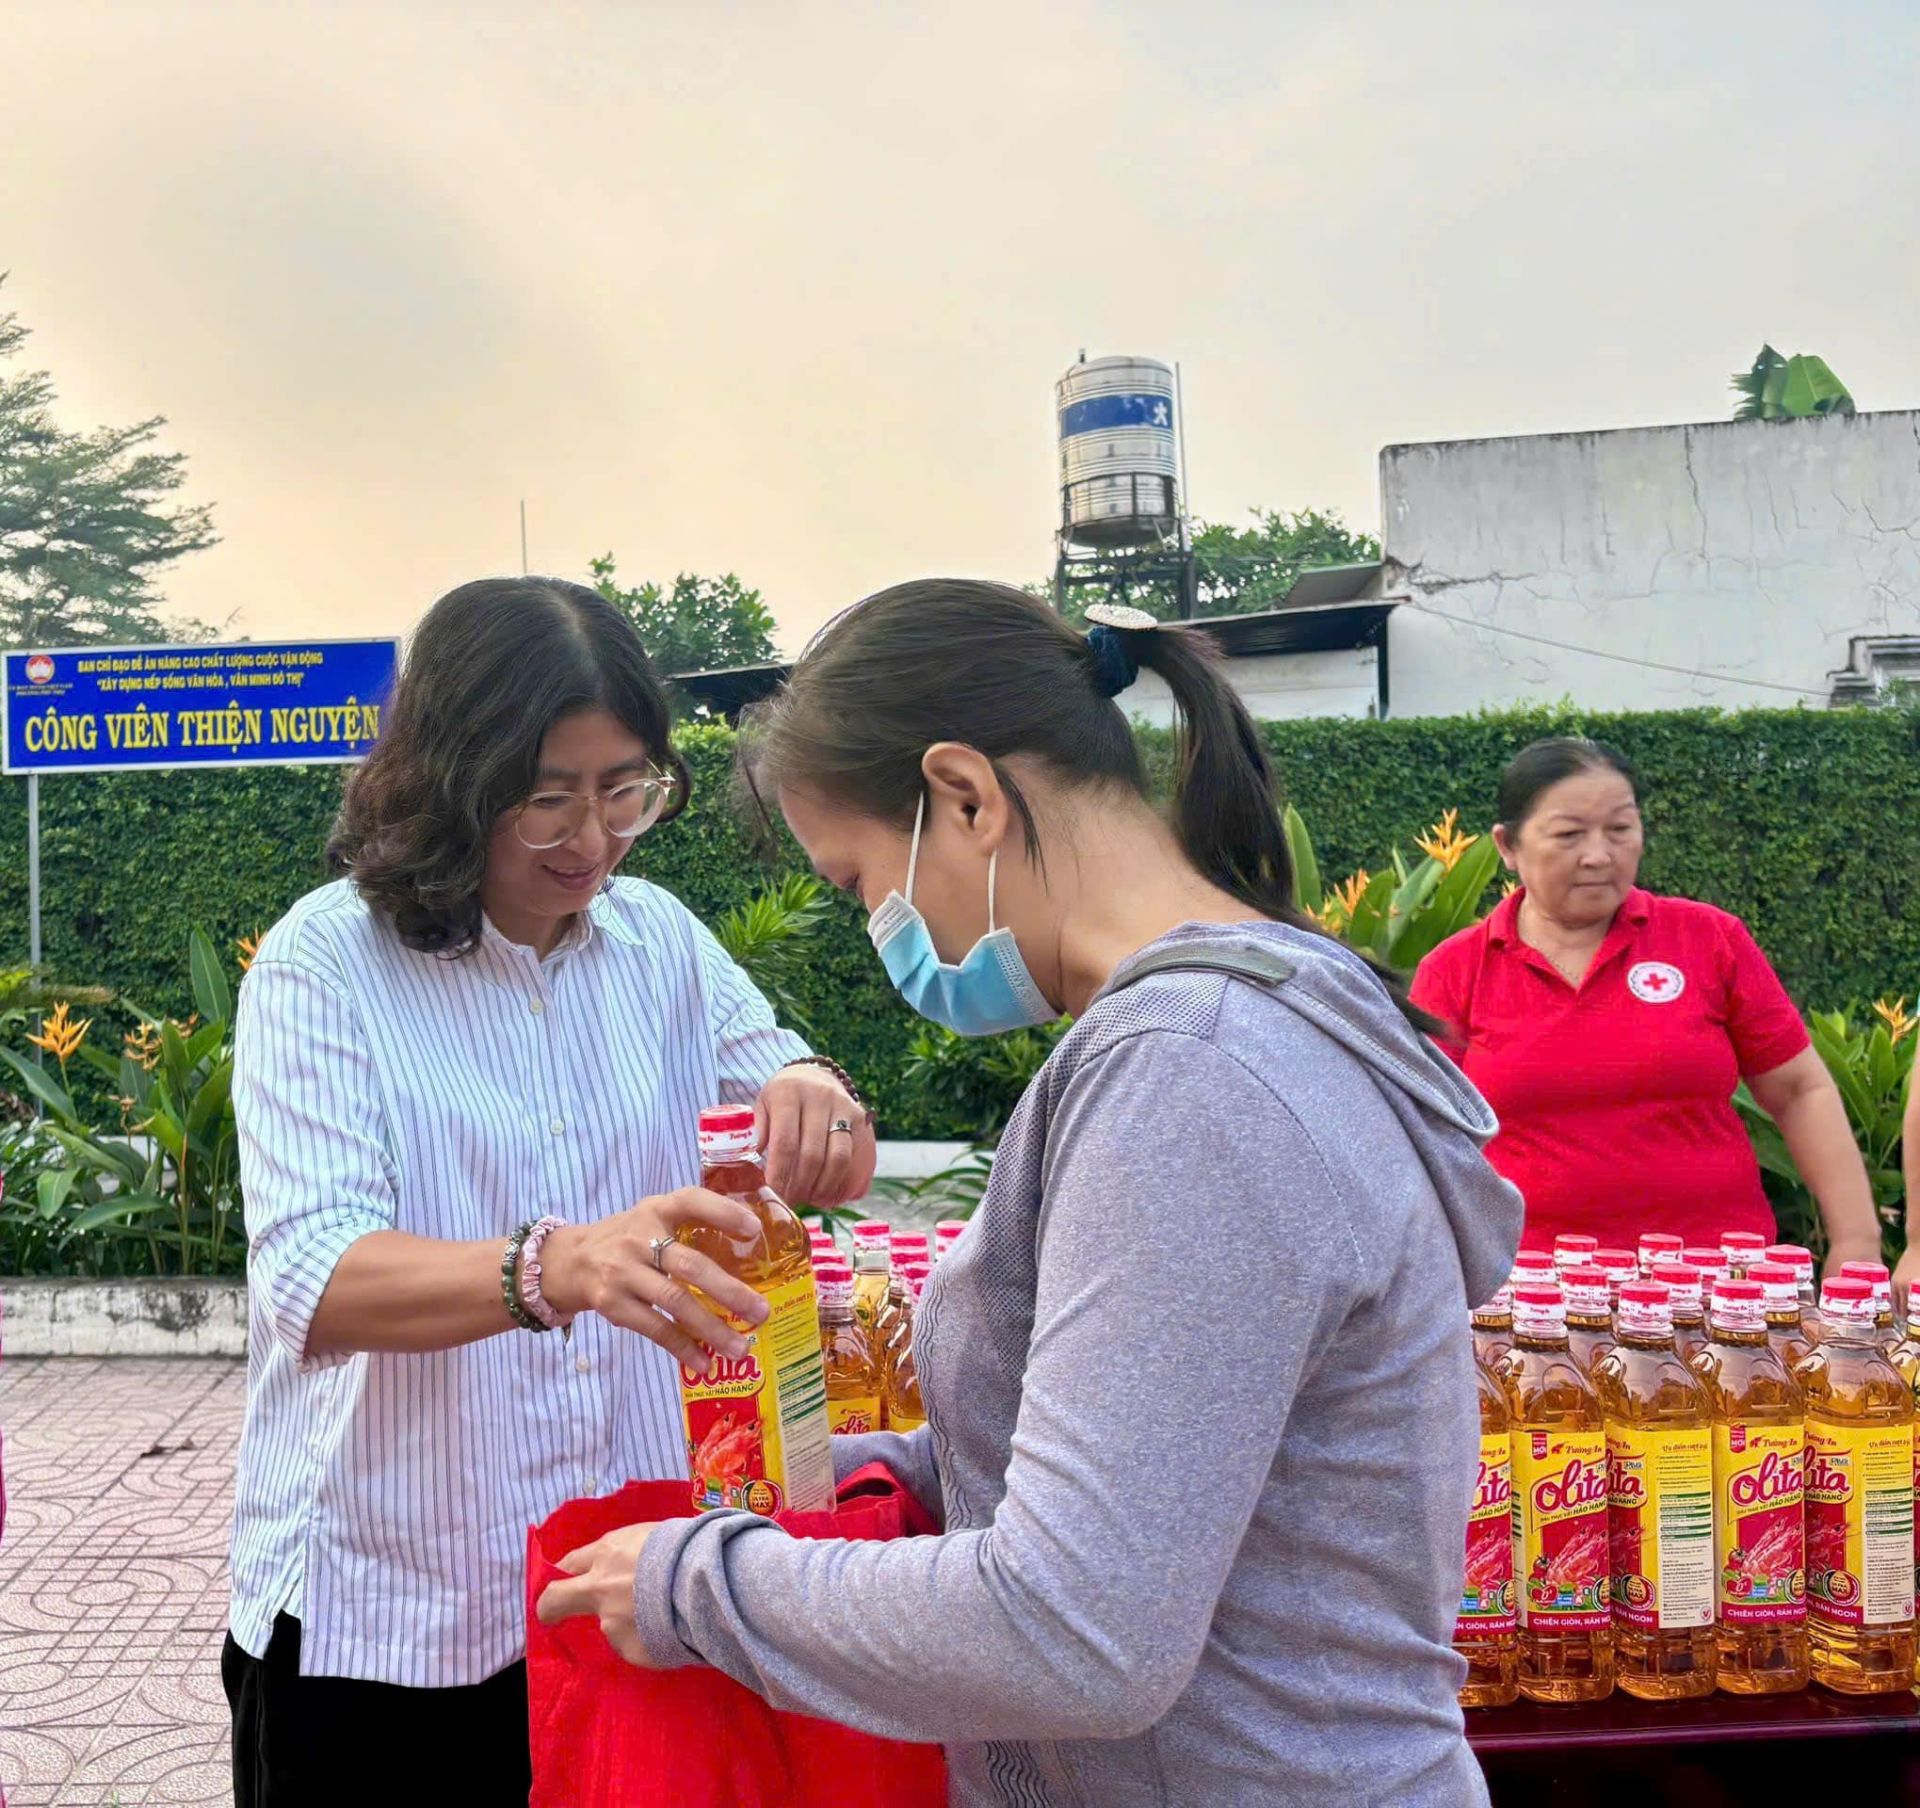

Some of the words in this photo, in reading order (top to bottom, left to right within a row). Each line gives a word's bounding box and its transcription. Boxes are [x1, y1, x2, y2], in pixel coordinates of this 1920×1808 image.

[78, 660, 95, 672] BAN
[183, 656, 200, 670] CAO
[202, 651, 225, 668] CHẤT
[226, 653, 254, 670] LƯỢNG
[255, 651, 278, 669] CUỘC
[299, 650, 323, 668] ĐỘNG
[162, 672, 185, 689] SỐNG
[249, 672, 272, 686] MINH
[25, 705, 98, 752] CÔNG
[104, 702, 169, 750] VIÊN
[177, 699, 262, 754] THIỆN
[270, 695, 380, 749] NGUYỆN
